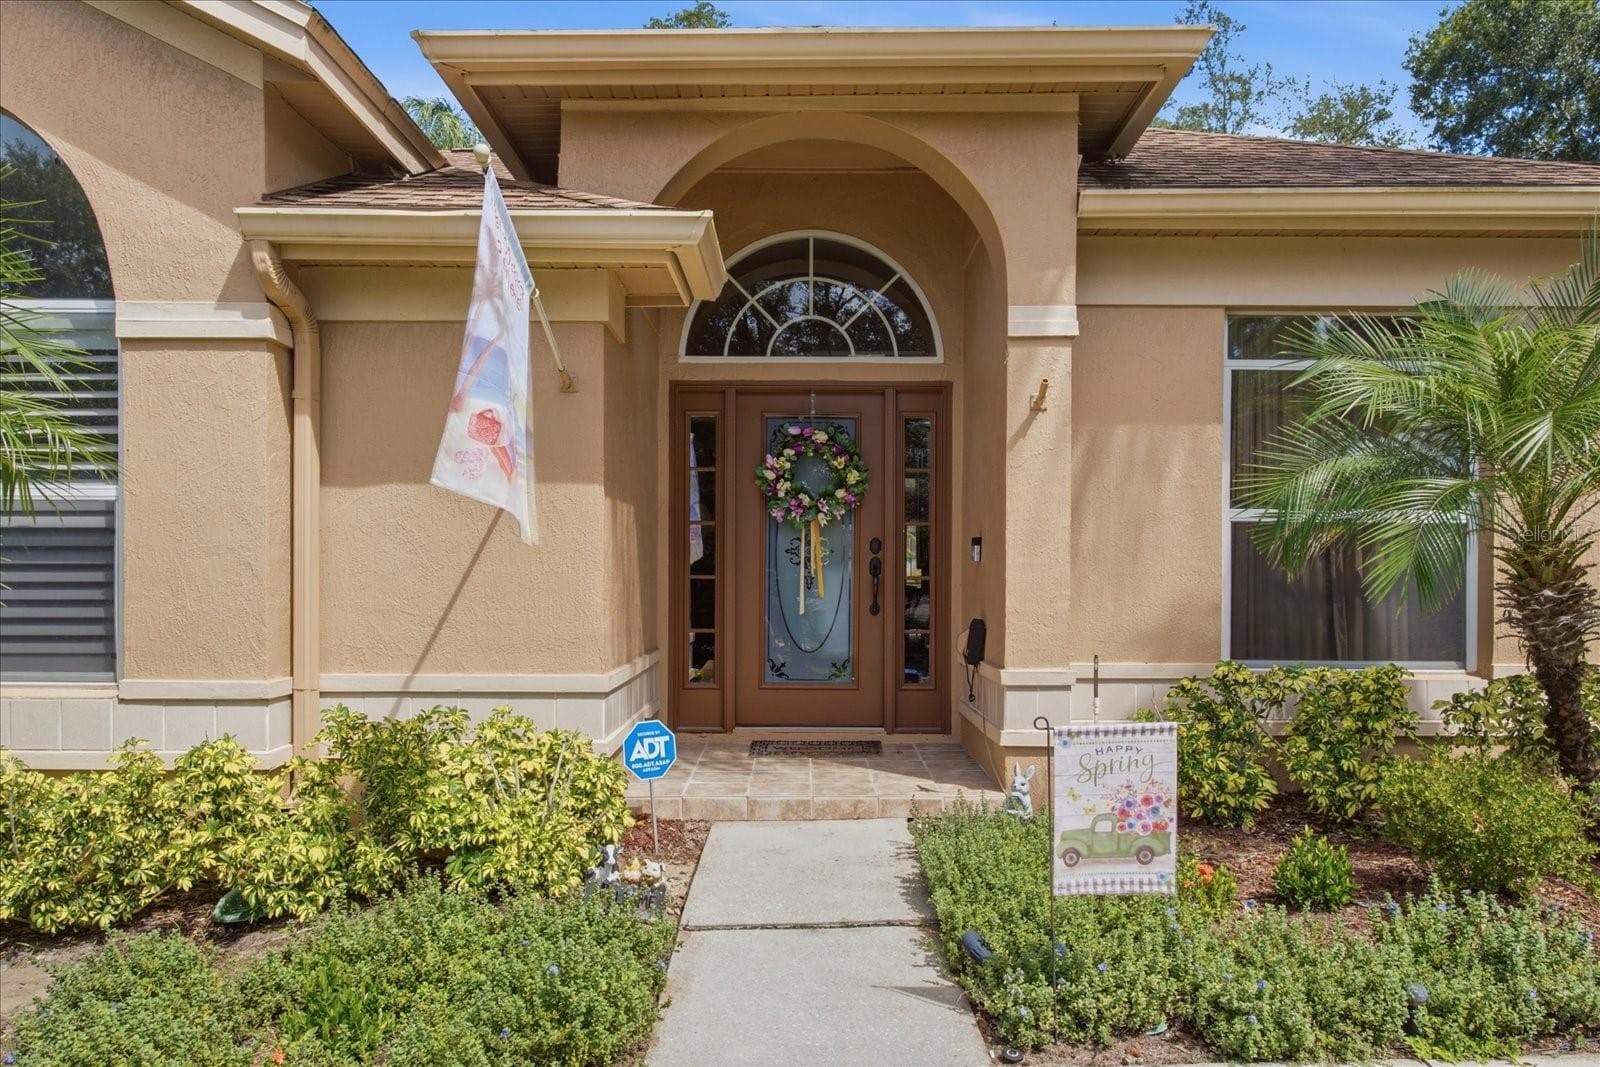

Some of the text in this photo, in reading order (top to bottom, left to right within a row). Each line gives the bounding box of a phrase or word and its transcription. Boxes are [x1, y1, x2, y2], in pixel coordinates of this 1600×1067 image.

[629, 735, 670, 762] ADT
[1095, 744, 1144, 756] HAPPY
[1076, 752, 1157, 788] Spring
